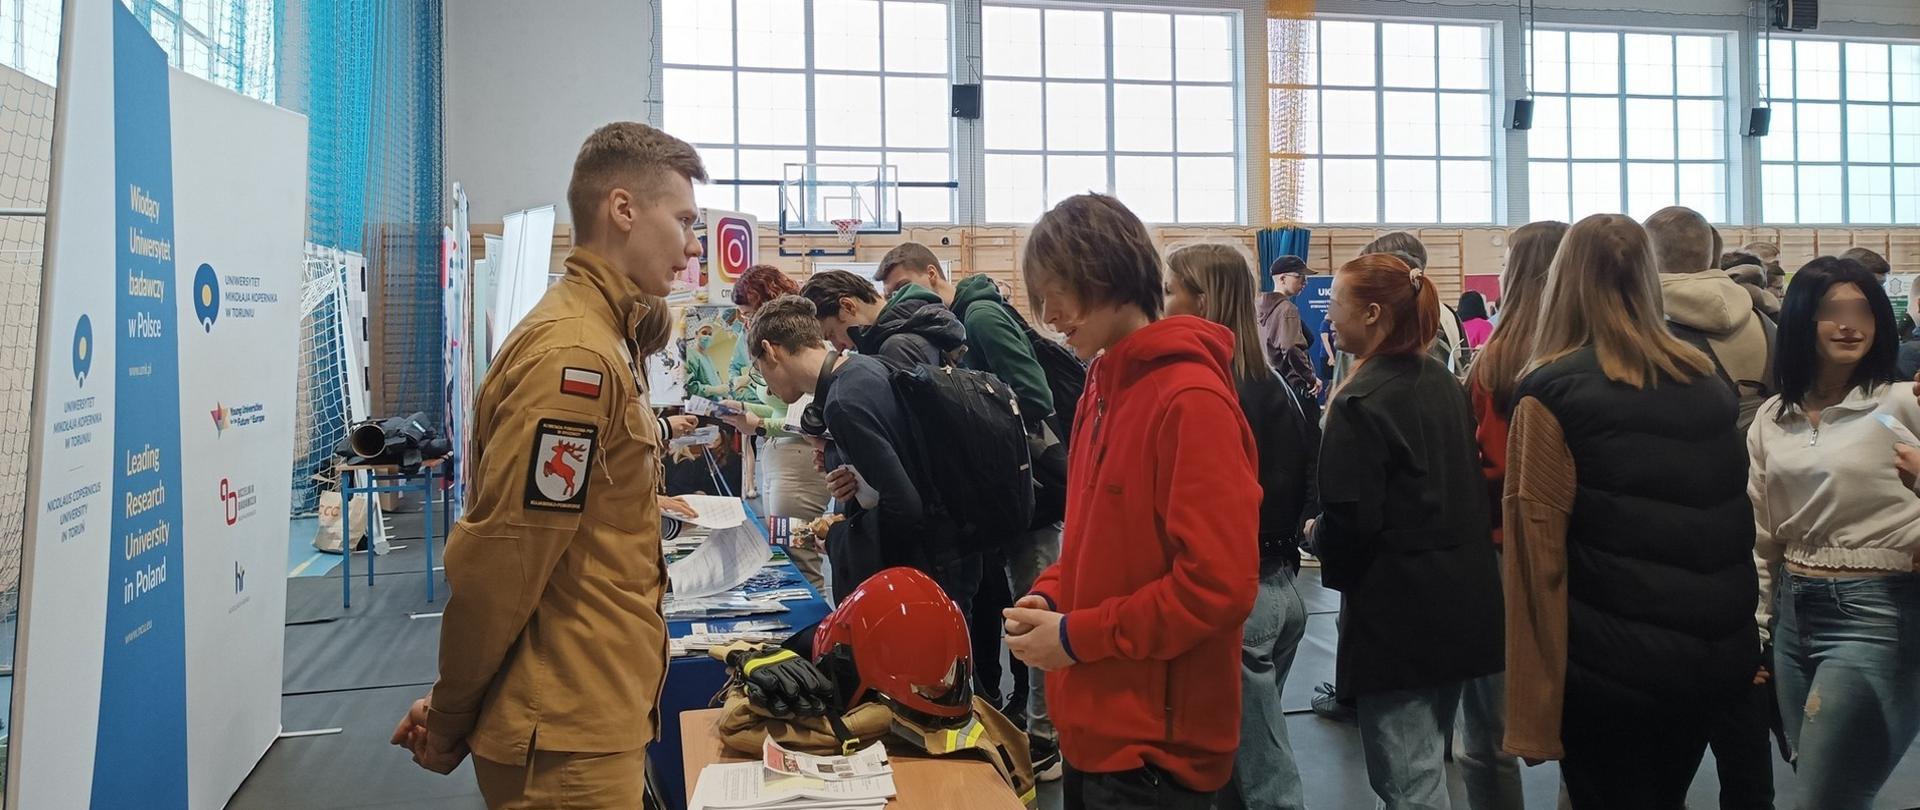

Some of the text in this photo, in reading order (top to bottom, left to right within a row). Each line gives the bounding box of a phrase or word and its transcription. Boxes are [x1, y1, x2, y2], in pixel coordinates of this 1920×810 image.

[129, 183, 160, 225] Wiodący
[129, 226, 172, 265] Uniwersytet
[128, 268, 165, 303] badawczy
[224, 275, 261, 287] UNIWERSYTET
[128, 311, 162, 338] w Polsce
[225, 307, 255, 318] W TORUNIU
[63, 396, 96, 413] UNIWERSYTET
[64, 431, 92, 449] W TORUNIU
[126, 443, 160, 476] Leading
[46, 481, 101, 513] NICOLAUS COPERNICUS
[125, 479, 165, 519] Research
[59, 503, 88, 526] UNIVERSITY
[61, 530, 68, 543] IN
[125, 519, 170, 561] University
[124, 555, 167, 605] in Poland
